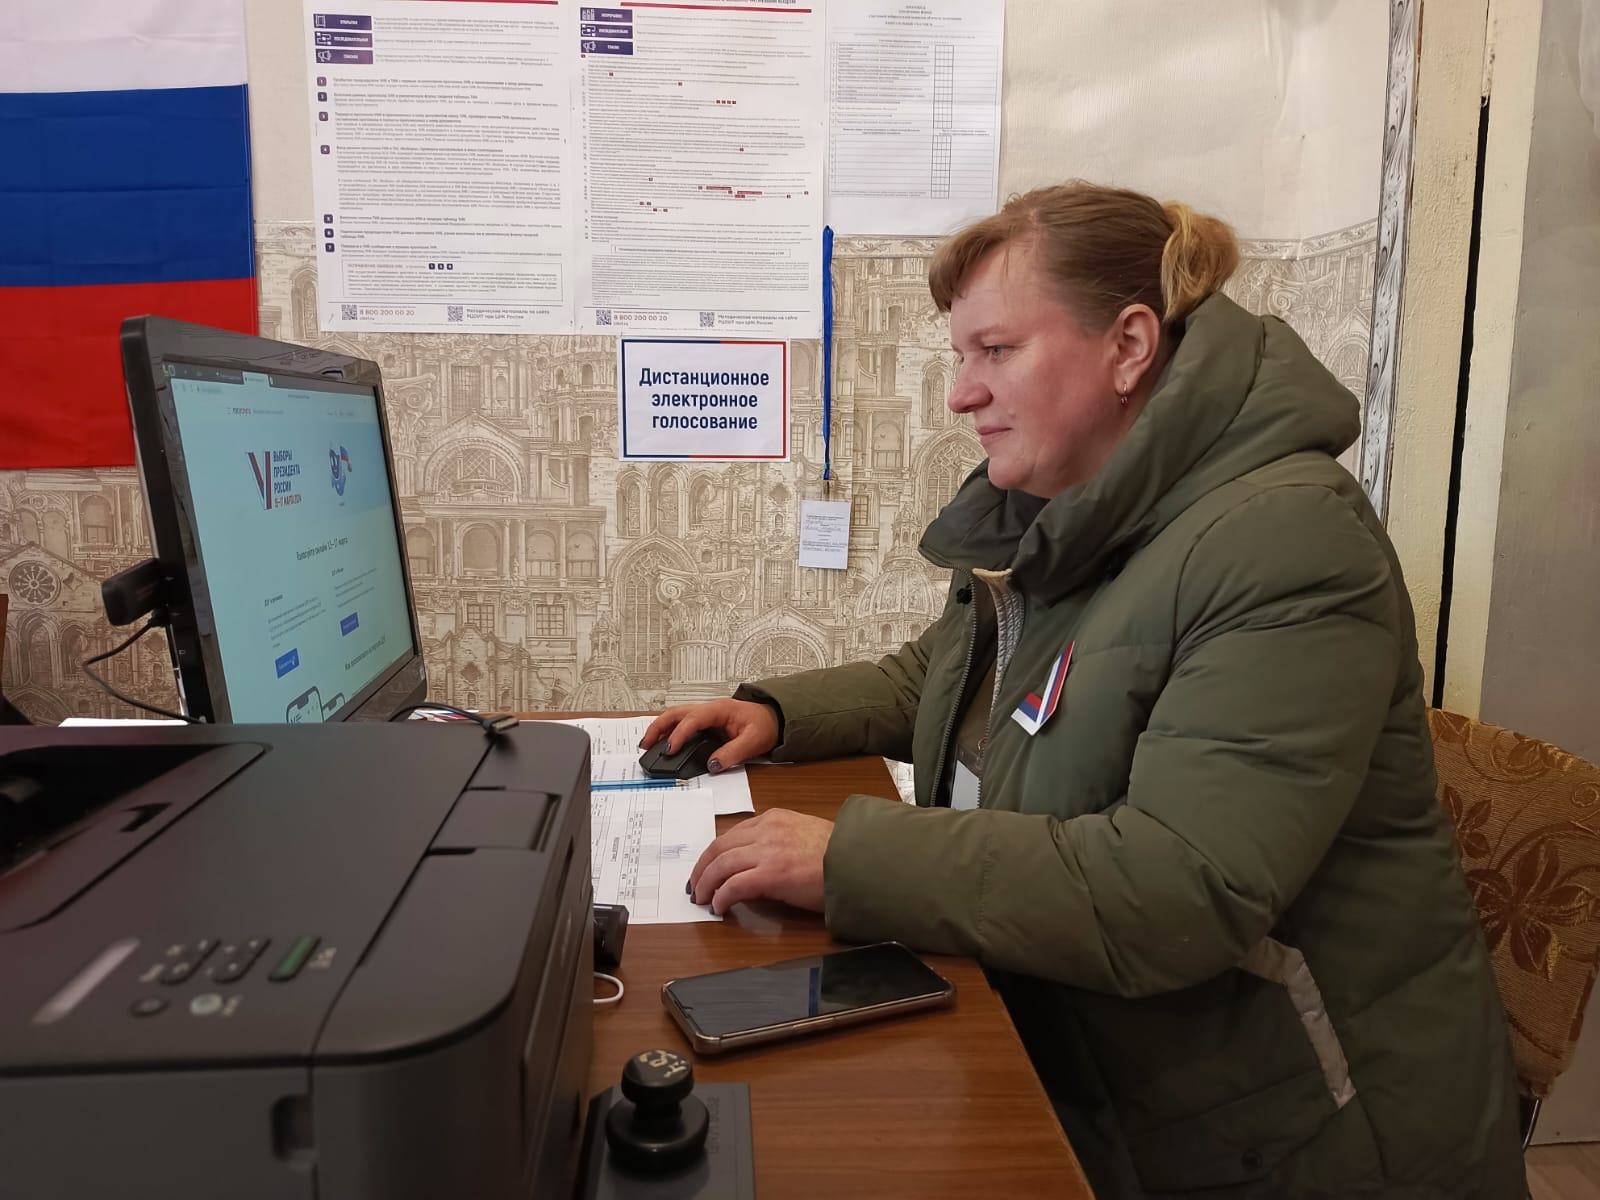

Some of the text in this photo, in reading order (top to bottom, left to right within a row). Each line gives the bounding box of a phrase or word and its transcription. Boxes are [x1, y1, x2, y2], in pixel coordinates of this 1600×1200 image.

[639, 368, 770, 387] Дистанционное
[652, 393, 758, 410] электронное
[652, 415, 758, 430] голосование
[273, 450, 292, 462] ВЫБОРЫ
[274, 464, 301, 478] ПРЕЗИДЕНТА
[274, 481, 292, 494] РОССИИ
